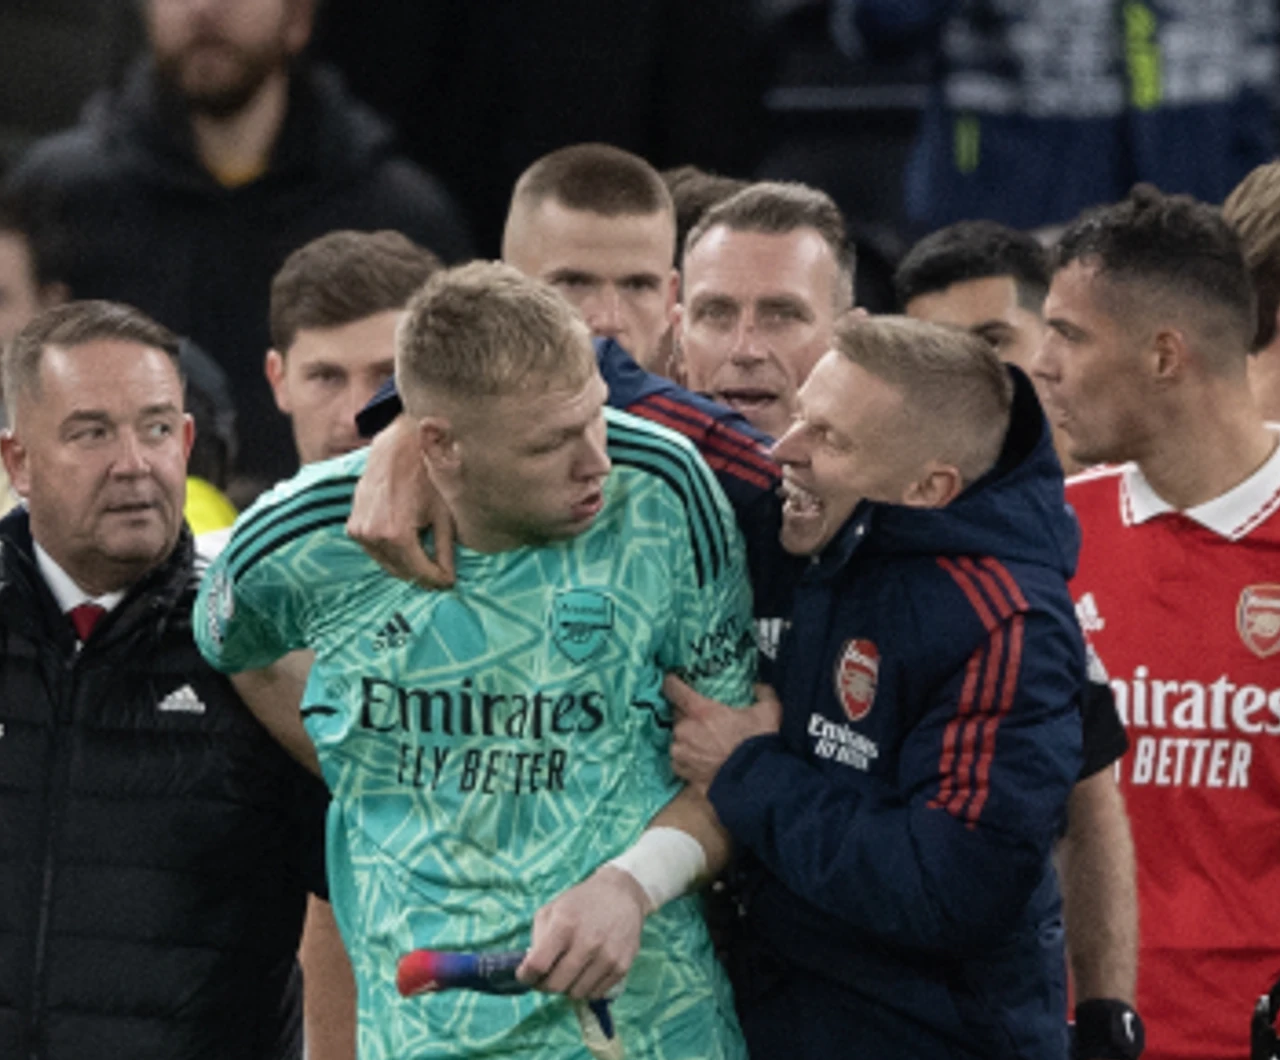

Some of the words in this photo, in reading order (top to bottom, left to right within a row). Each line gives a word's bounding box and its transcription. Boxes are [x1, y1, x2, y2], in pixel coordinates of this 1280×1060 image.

[361, 676, 605, 740] Emirates
[397, 742, 450, 790] FLY
[1131, 735, 1253, 789] BETTER
